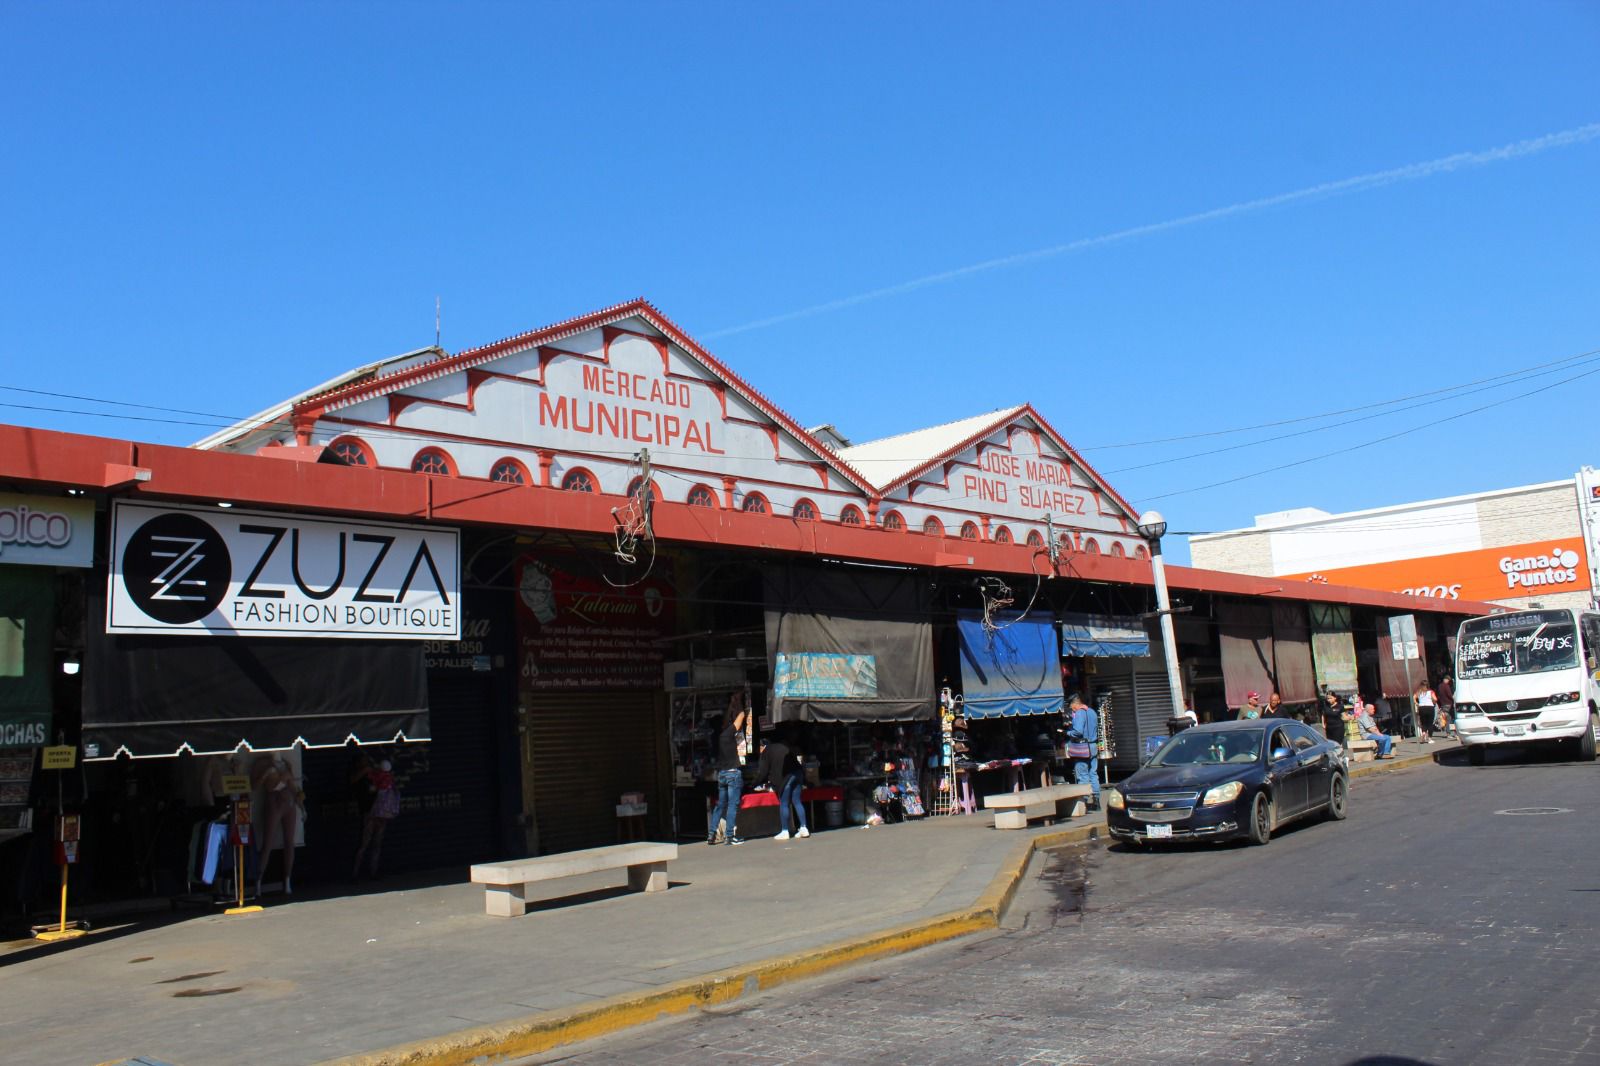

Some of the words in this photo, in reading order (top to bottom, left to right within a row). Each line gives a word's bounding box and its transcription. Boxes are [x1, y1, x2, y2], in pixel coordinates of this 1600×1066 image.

[582, 364, 690, 409] MERCADO
[539, 392, 725, 455] MUNICIPAL
[982, 451, 1020, 478] JOSE
[1025, 459, 1069, 488] MARIA
[964, 475, 1007, 504] PINO
[1019, 485, 1085, 515] SUAREZ
[237, 524, 451, 606] ZUZA
[1499, 555, 1550, 573] Gana
[1506, 567, 1578, 589] Puntos
[233, 601, 337, 625] FASHION
[345, 606, 452, 628] BOUTIQUE
[455, 641, 483, 654] 1950
[1459, 642, 1491, 651] CENTRO
[1473, 632, 1510, 644] ALEMAN
[1459, 653, 1490, 662] MERCADO
[1459, 665, 1515, 679] INSURGENTES
